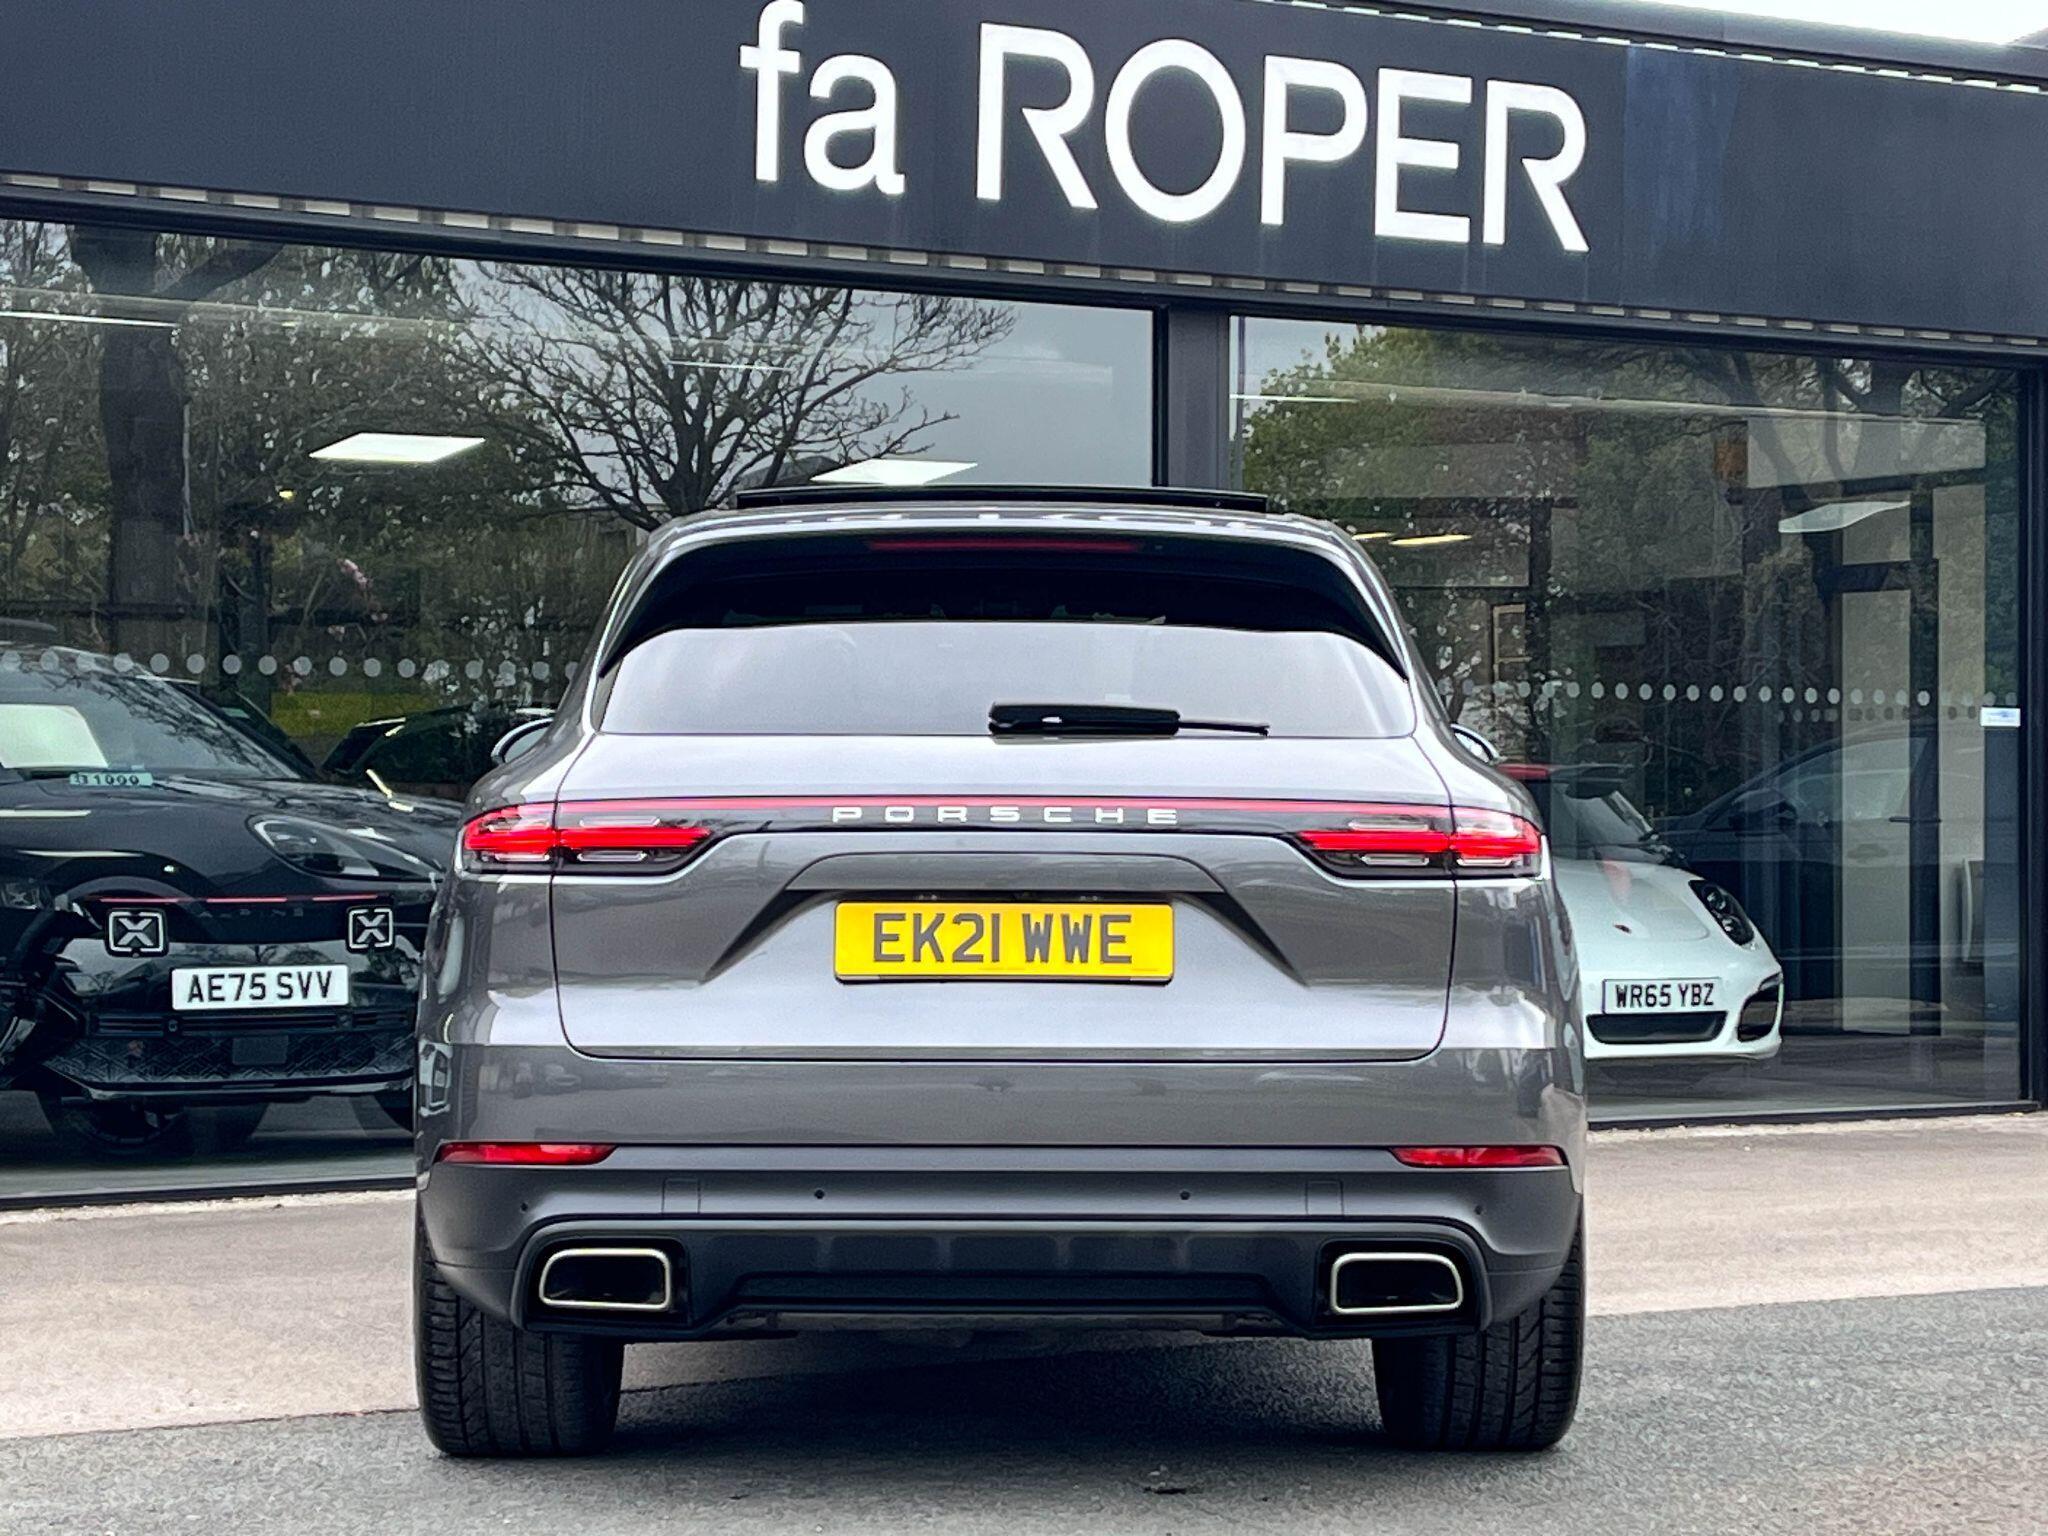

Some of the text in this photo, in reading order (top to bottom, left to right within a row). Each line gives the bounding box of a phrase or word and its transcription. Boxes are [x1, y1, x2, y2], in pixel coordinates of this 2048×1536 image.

[739, 0, 1590, 252] fa ROPER
[832, 806, 1178, 824] PORSCHE
[873, 912, 1132, 964] EK21 WWE
[187, 971, 332, 1003] AE75 SVV
[1615, 983, 1714, 1008] WR65 YBZ
